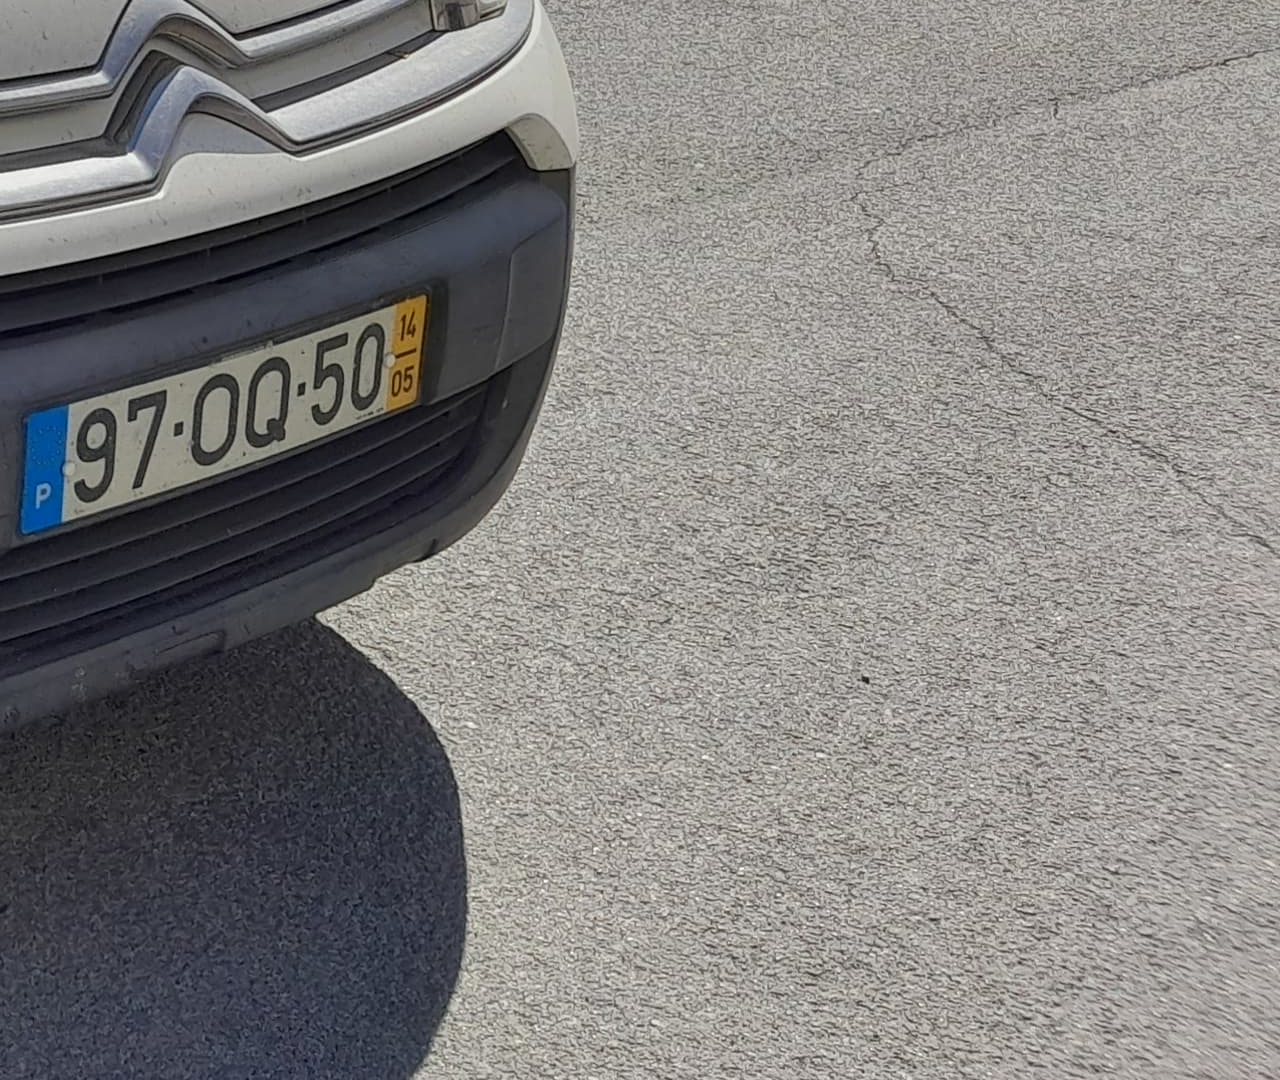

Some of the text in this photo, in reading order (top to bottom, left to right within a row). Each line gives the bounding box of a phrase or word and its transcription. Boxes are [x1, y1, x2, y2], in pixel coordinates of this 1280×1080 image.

[400, 306, 417, 342] 14
[391, 364, 416, 397] 05
[35, 482, 52, 510] P
